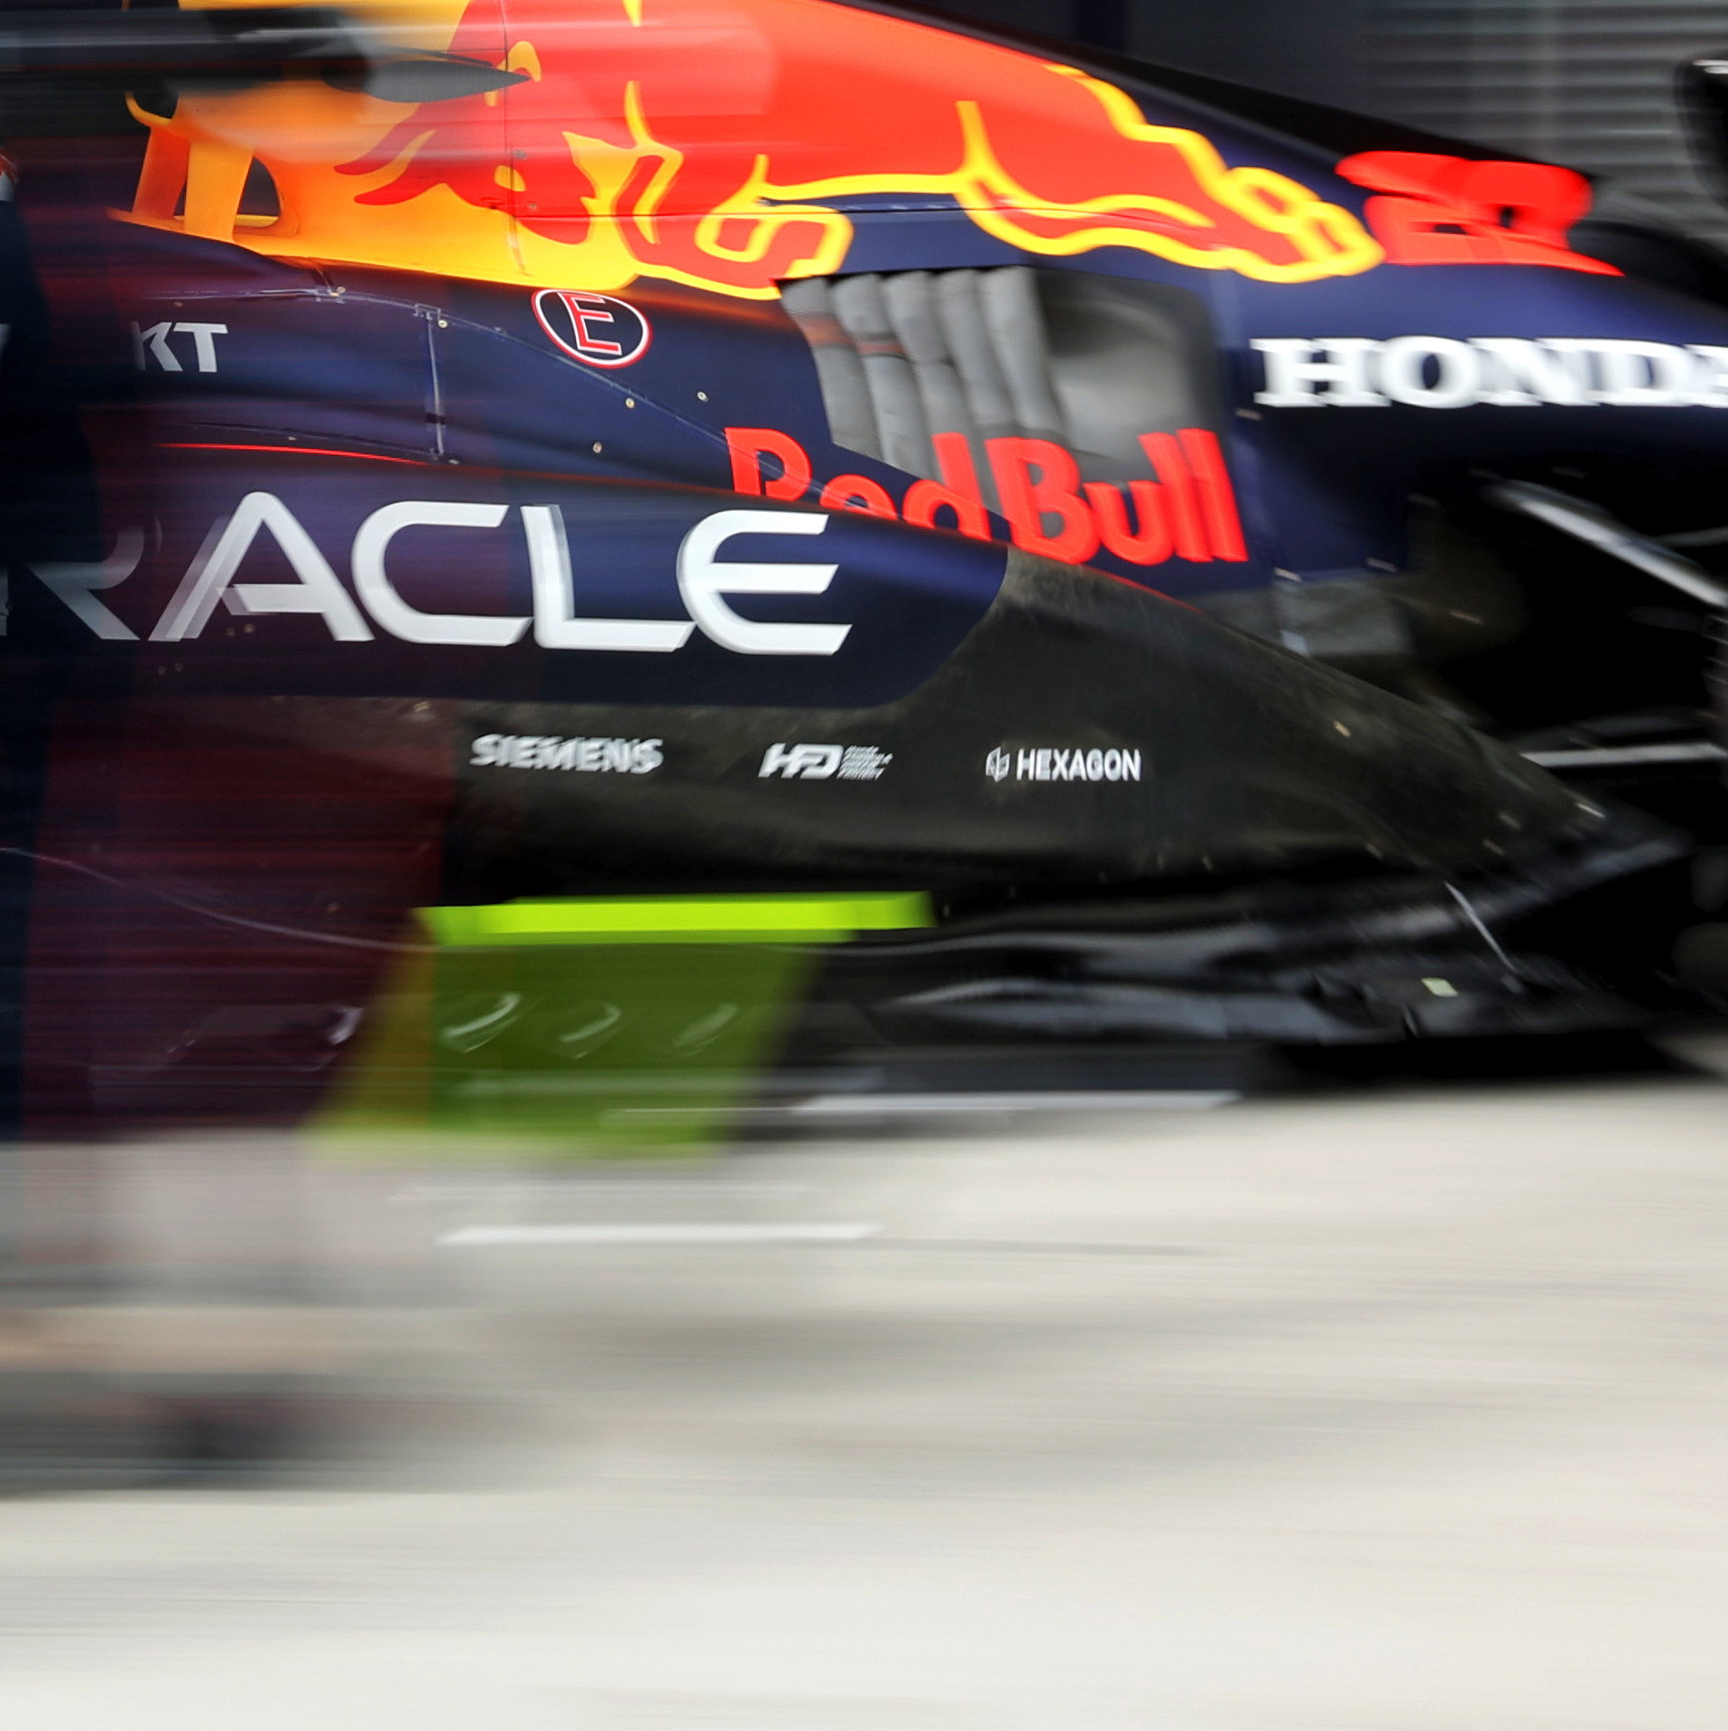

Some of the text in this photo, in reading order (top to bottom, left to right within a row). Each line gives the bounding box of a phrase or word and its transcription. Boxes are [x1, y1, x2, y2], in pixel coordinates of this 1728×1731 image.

[133, 321, 229, 373] KT
[557, 291, 623, 356] E
[984, 427, 1249, 565] Bull
[469, 734, 665, 775] SIEMENS
[1016, 748, 1142, 782] HEXAGON
